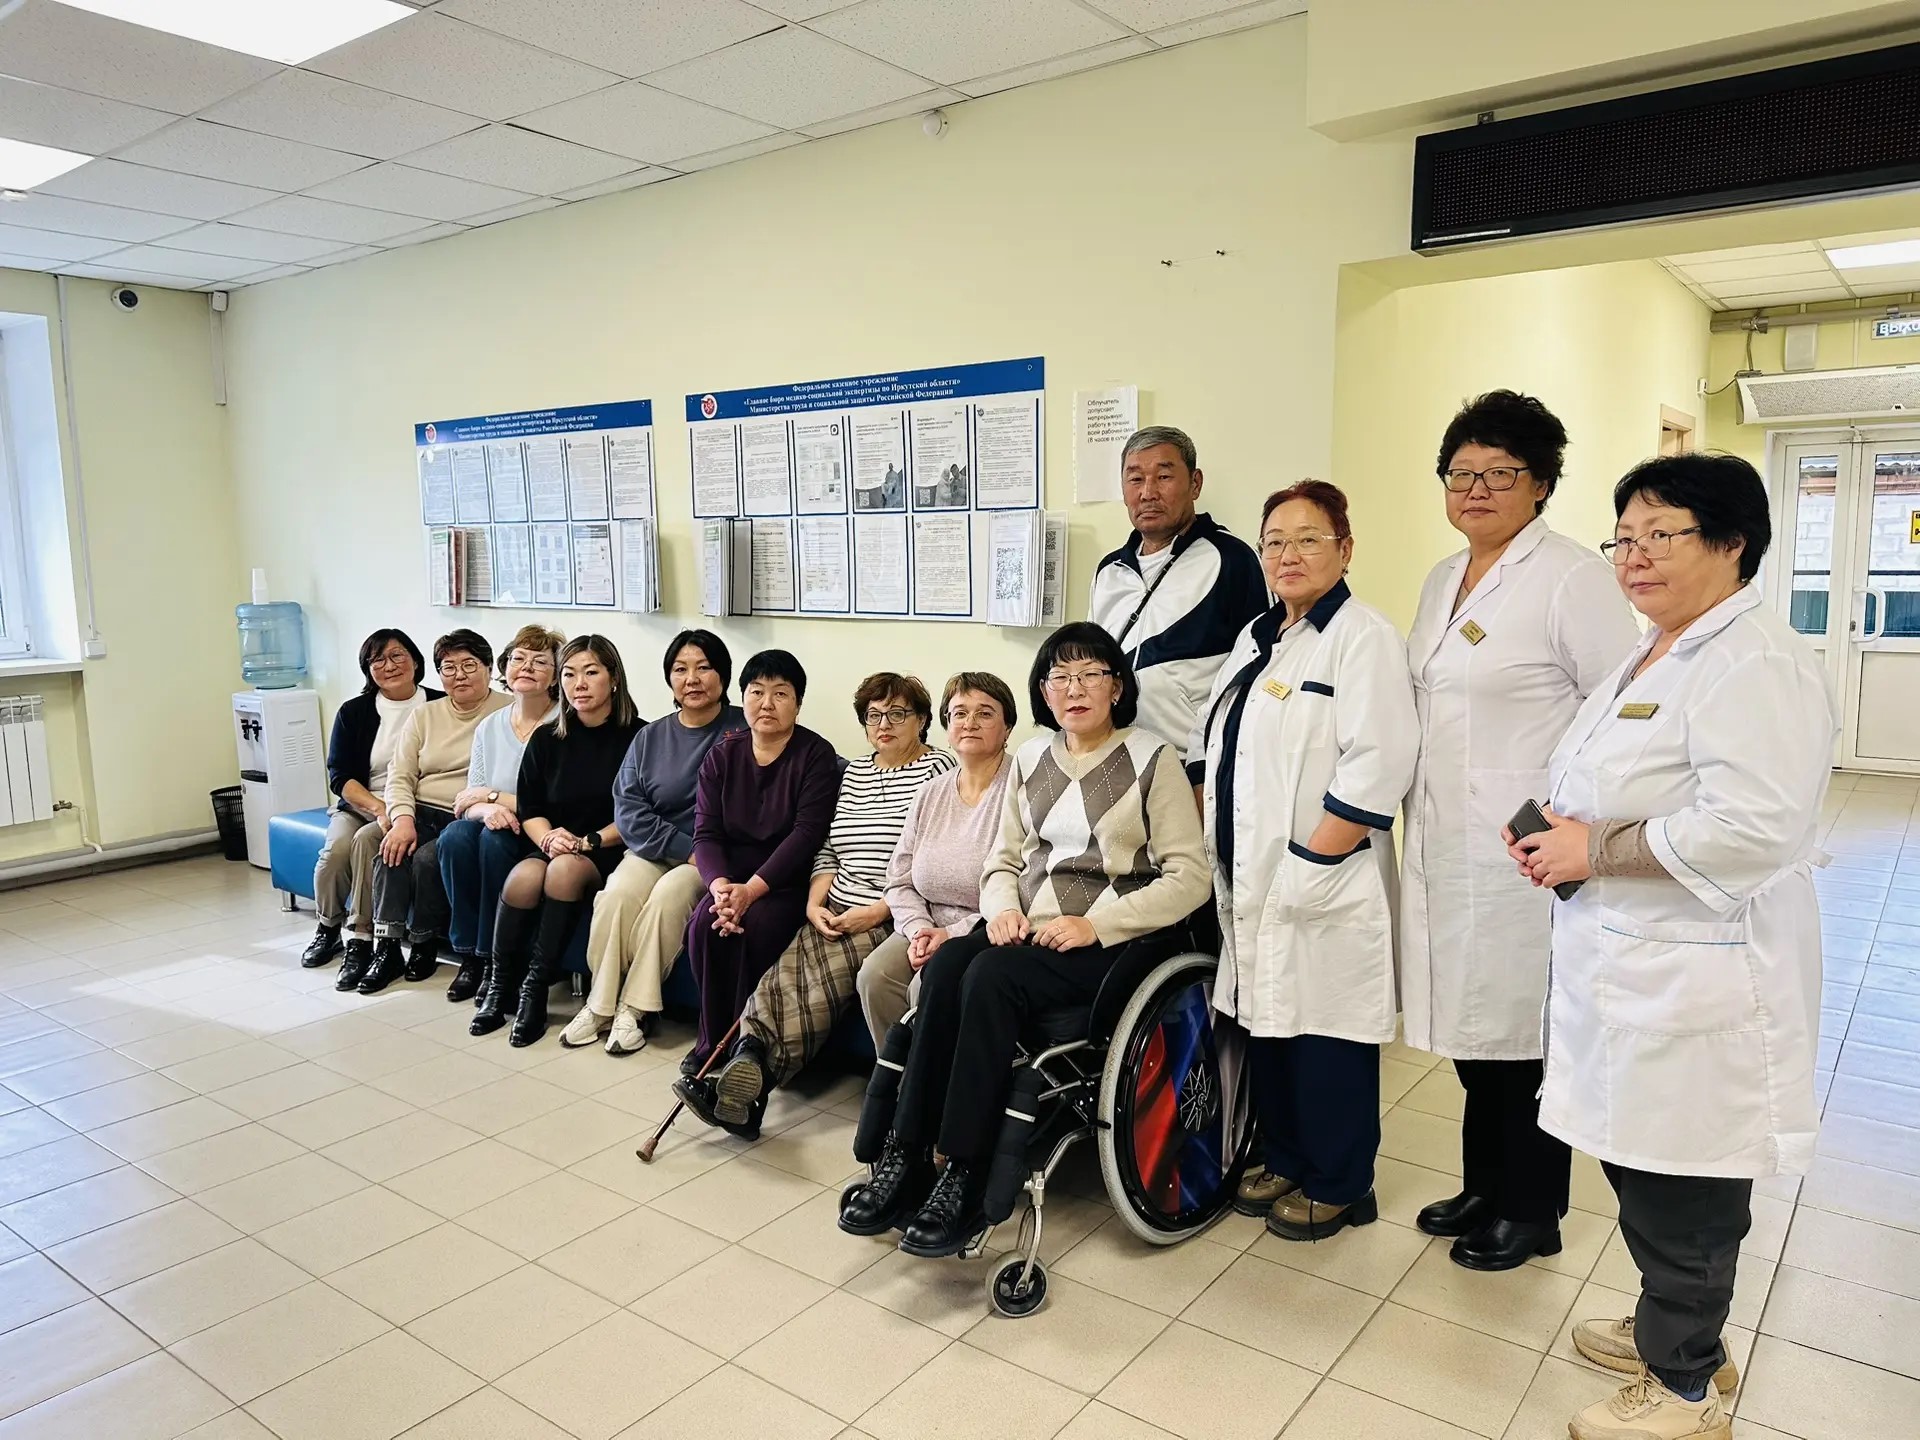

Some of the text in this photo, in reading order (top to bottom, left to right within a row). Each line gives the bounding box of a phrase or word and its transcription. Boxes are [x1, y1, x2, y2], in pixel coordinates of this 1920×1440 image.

[743, 396, 769, 406] «Главное
[769, 394, 785, 405] бюро
[785, 388, 843, 402] медико-социальной
[844, 384, 881, 397] экспертизы
[891, 381, 928, 392] Иркутской
[929, 378, 961, 387] области»
[792, 375, 898, 392] Федеральное казенное учреждение
[750, 404, 790, 414] Министерства
[791, 402, 808, 412] труда
[813, 398, 849, 408] социальной
[850, 396, 876, 404] защиты
[876, 391, 914, 402] Российской
[915, 388, 954, 398] Федерации
[1101, 428, 1122, 436] рабочей
